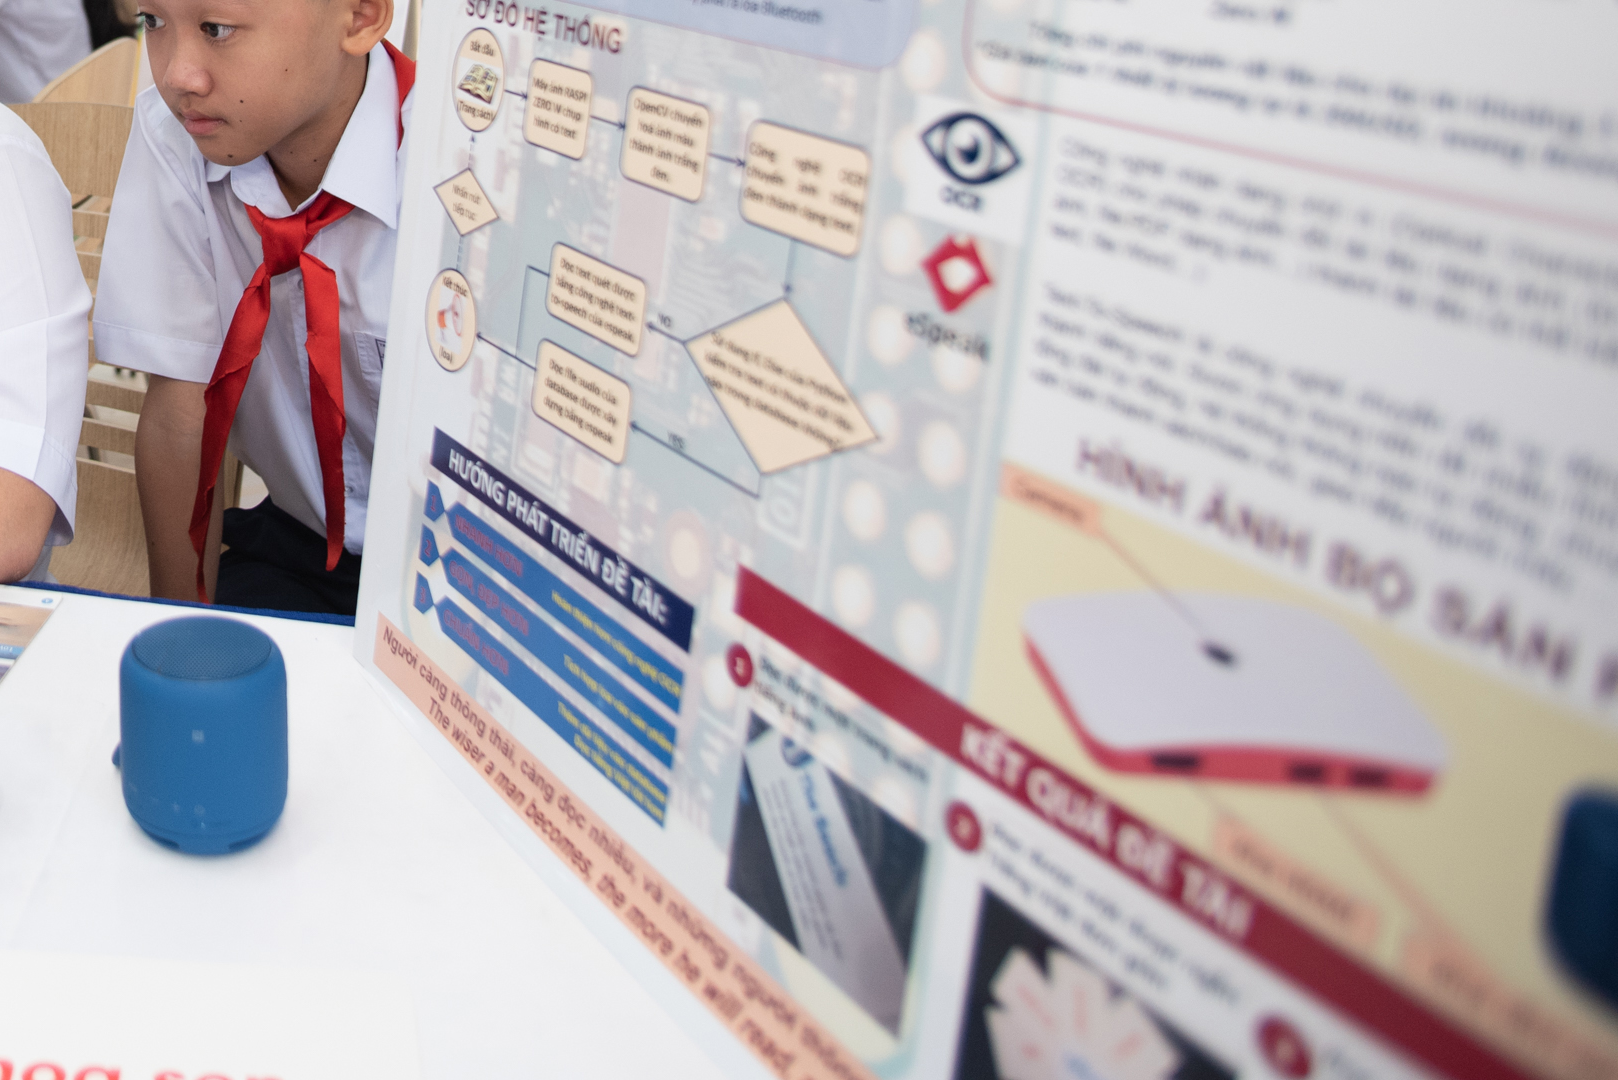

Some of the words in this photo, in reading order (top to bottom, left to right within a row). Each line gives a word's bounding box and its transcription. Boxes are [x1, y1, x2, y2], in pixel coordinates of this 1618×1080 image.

[553, 11, 622, 54] THỐNG
[448, 447, 504, 508] HƯỚNG
[506, 488, 549, 535] PHÁT
[550, 518, 600, 576] TRIỂN
[601, 554, 627, 597] ĐỀ
[382, 625, 419, 669] Người
[418, 661, 448, 701] càng
[450, 689, 487, 738] thông
[488, 726, 517, 768] thái,
[520, 758, 555, 803] càng
[557, 792, 587, 829] đọc
[428, 696, 450, 732] The
[452, 724, 486, 764] wiser
[485, 760, 495, 776] a
[494, 770, 526, 807] man
[960, 721, 1026, 790] KẾT
